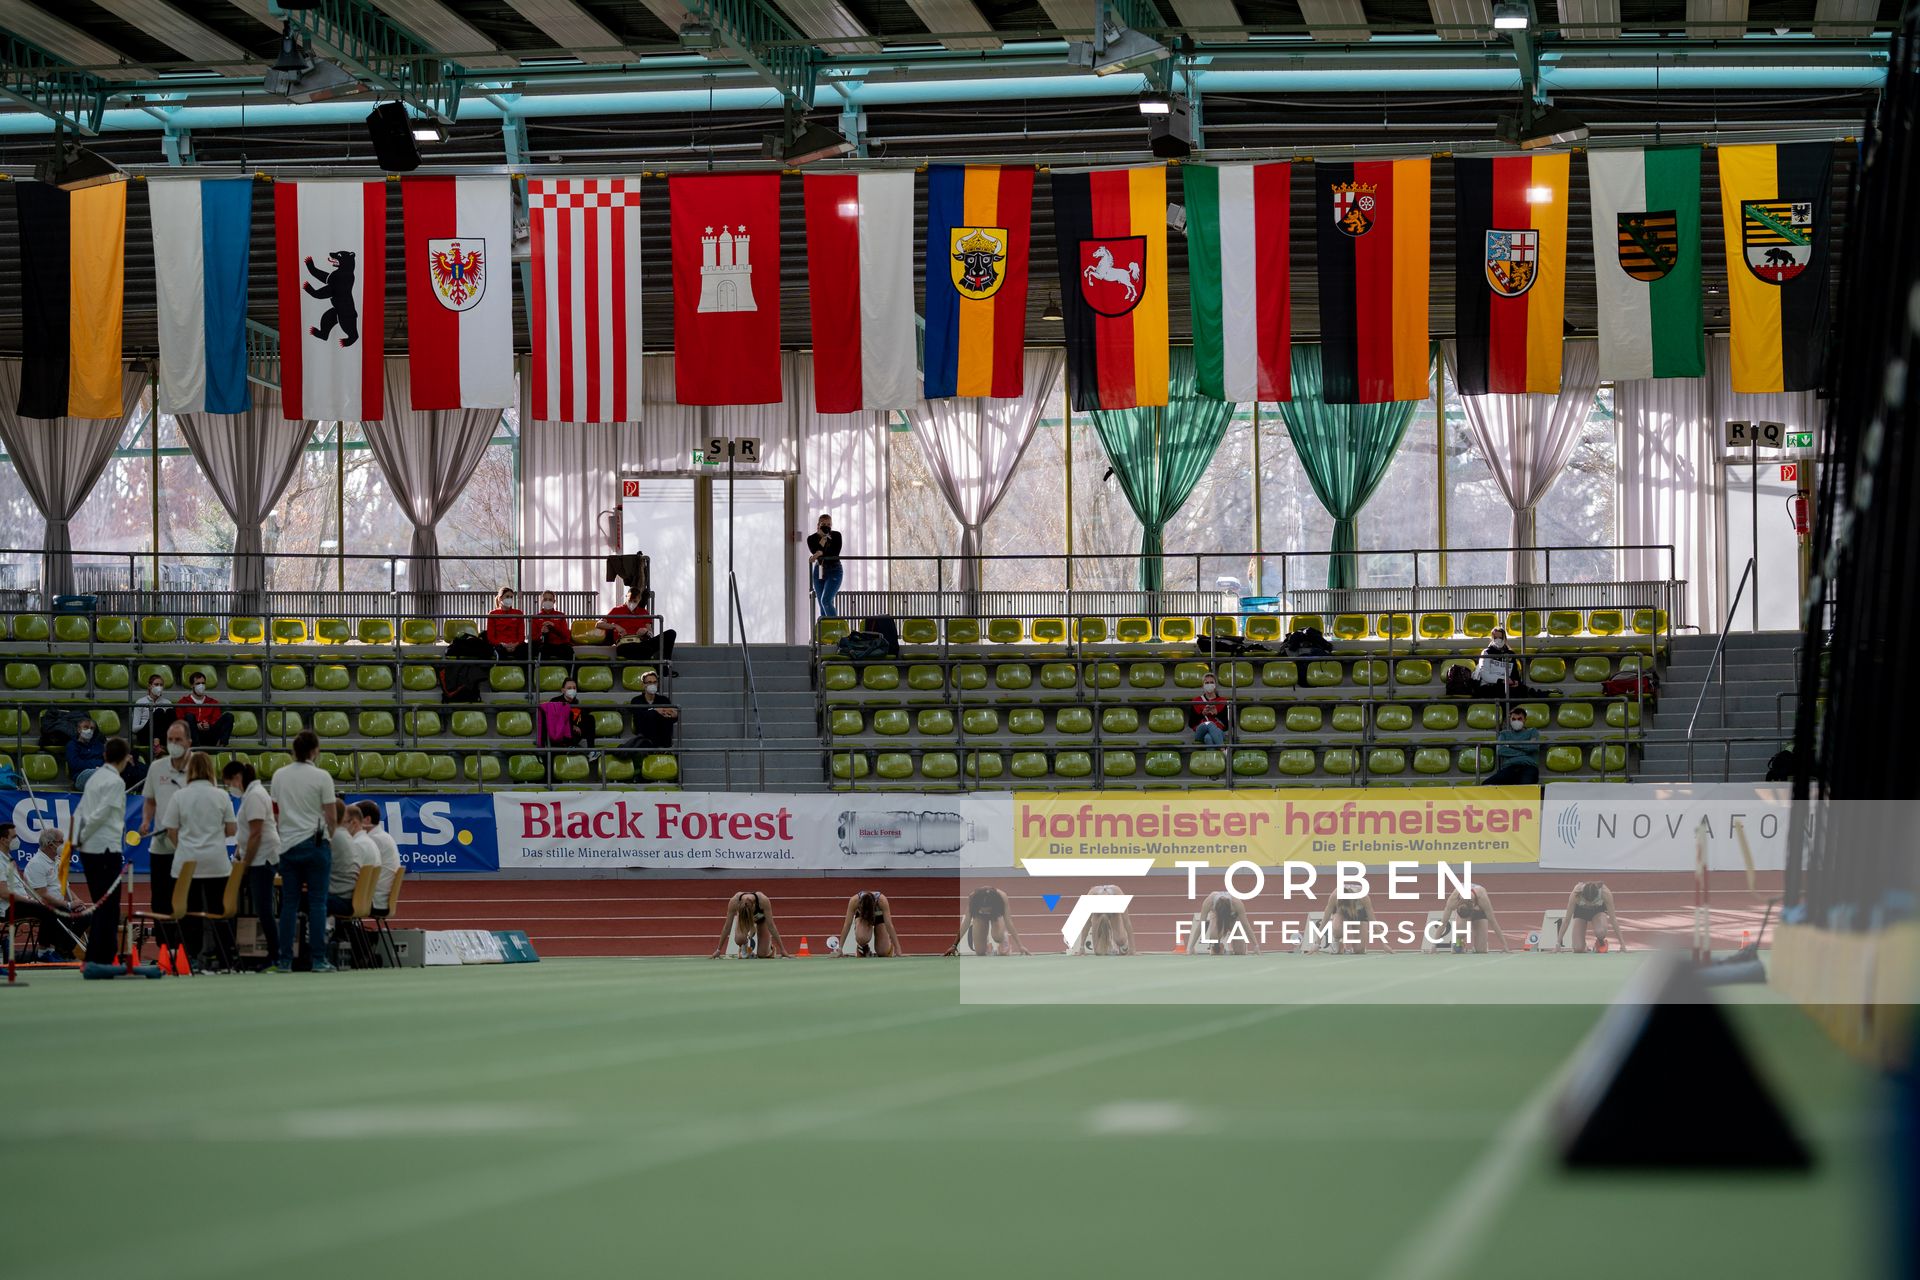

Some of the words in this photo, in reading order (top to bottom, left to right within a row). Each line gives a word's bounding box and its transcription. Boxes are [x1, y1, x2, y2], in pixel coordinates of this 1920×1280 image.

[1732, 424, 1745, 438] R
[1764, 424, 1779, 441] Q
[710, 440, 722, 454] S
[742, 441, 754, 454] R
[521, 801, 644, 840] Black
[656, 802, 793, 841] Forest
[1022, 804, 1270, 838] hofmeister
[1285, 801, 1533, 836] hofmeister
[1050, 843, 1073, 855] Die
[1079, 842, 1247, 855] Erlebnis-Wohnzentren
[1312, 840, 1336, 852] Die
[1342, 839, 1509, 852] Erlebnis-Wohnzentren
[413, 852, 457, 866] People
[522, 847, 543, 858] Das
[546, 847, 575, 858] stille
[578, 847, 661, 859] Mineralwasser
[663, 850, 684, 859] aus
[687, 848, 712, 859] dem
[715, 848, 795, 860] Schwarzwald.
